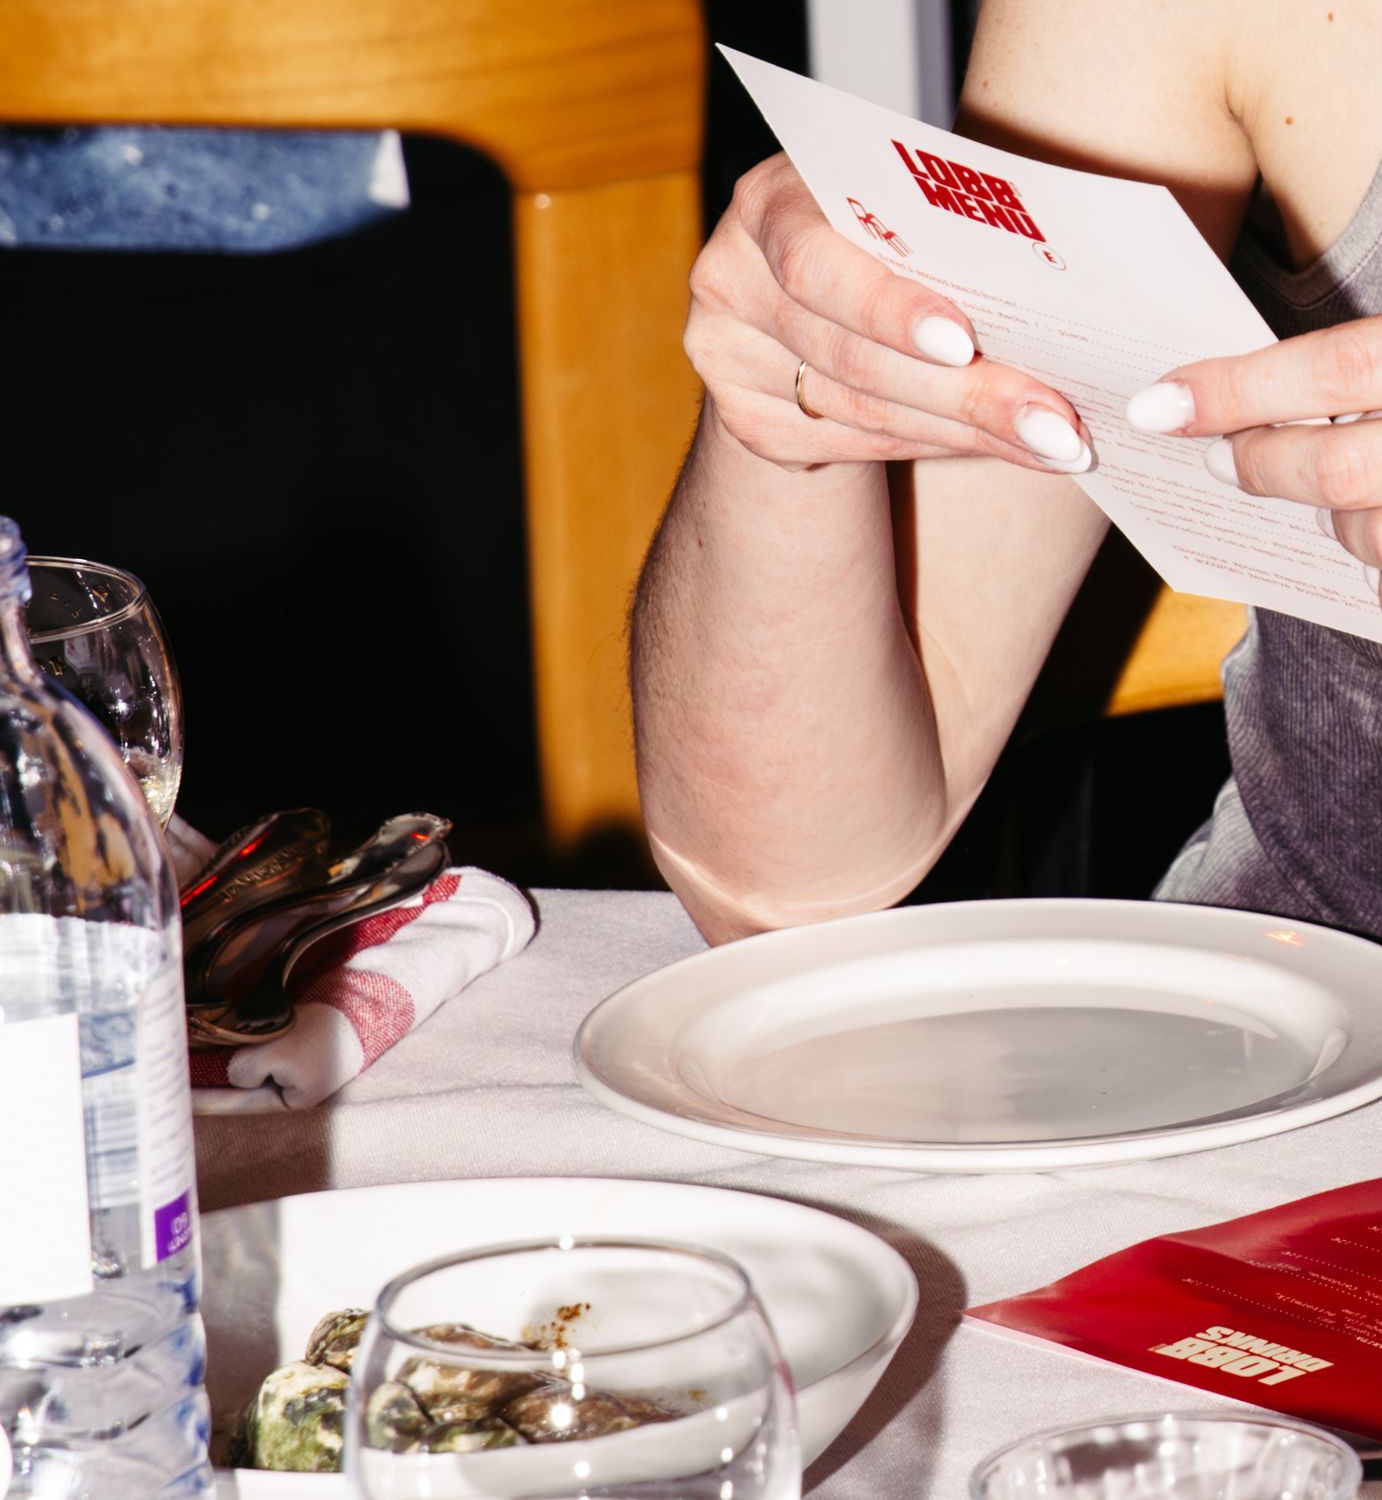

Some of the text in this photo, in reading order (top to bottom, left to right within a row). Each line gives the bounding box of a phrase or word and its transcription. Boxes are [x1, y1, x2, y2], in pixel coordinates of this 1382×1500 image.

[889, 138, 1027, 214] LOBB
[913, 175, 1047, 243] MENU
[1043, 249, 1058, 264] E
[1154, 1336, 1307, 1386] LOBB
[1195, 1325, 1335, 1373] DRINKS
